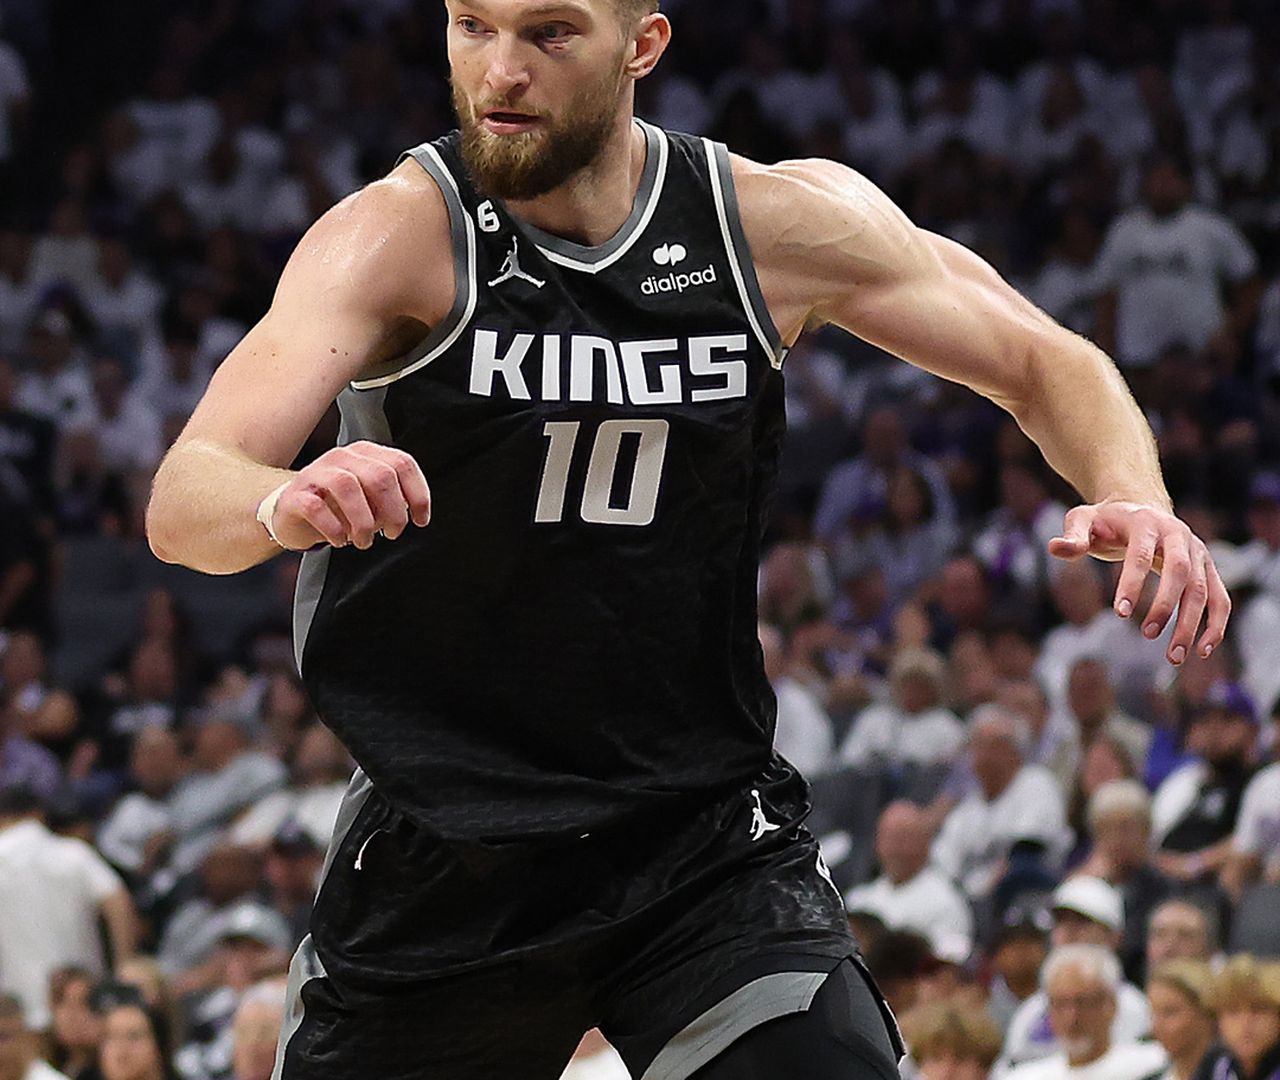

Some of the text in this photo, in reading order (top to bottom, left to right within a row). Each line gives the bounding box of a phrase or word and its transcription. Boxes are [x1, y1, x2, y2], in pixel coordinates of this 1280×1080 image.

[477, 200, 500, 232] 6
[640, 264, 717, 295] dialpad
[469, 329, 747, 406] KINGS
[534, 418, 670, 526] 10
